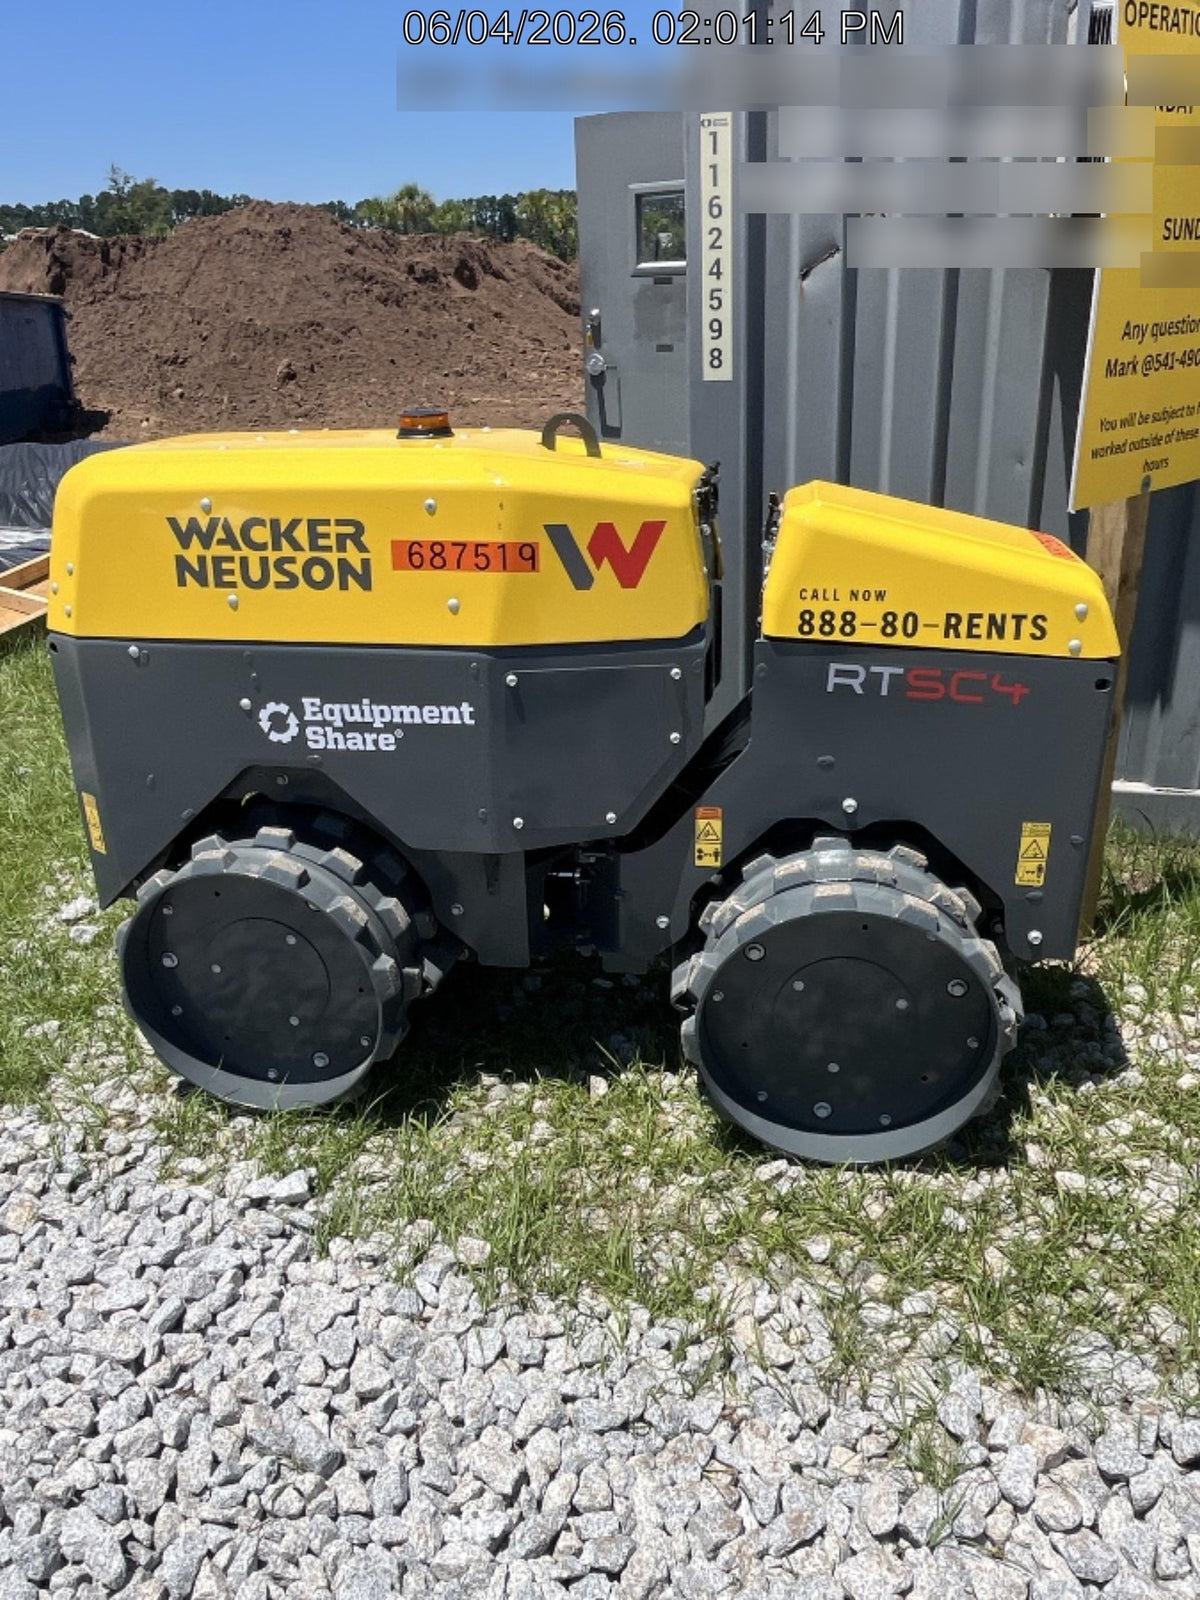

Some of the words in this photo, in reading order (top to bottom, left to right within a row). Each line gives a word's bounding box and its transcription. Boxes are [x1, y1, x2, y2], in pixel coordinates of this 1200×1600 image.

[1121, 320, 1149, 345] Any
[1105, 355, 1138, 378] Mark
[1100, 417, 1117, 432] You
[1120, 412, 1137, 428] will
[1137, 411, 1151, 426] be
[1151, 405, 1184, 425] subject
[1186, 404, 1195, 417] to
[1091, 439, 1127, 459] worked
[1128, 432, 1163, 452] outside
[1164, 428, 1175, 445] of
[1175, 427, 1199, 442] these
[1143, 457, 1169, 473] hours
[166, 516, 369, 554] WACKER
[408, 541, 536, 571] 687519
[175, 553, 373, 592] NEUSON
[799, 588, 841, 602] CALL
[849, 589, 887, 602] NOW
[301, 697, 475, 728] Equipment
